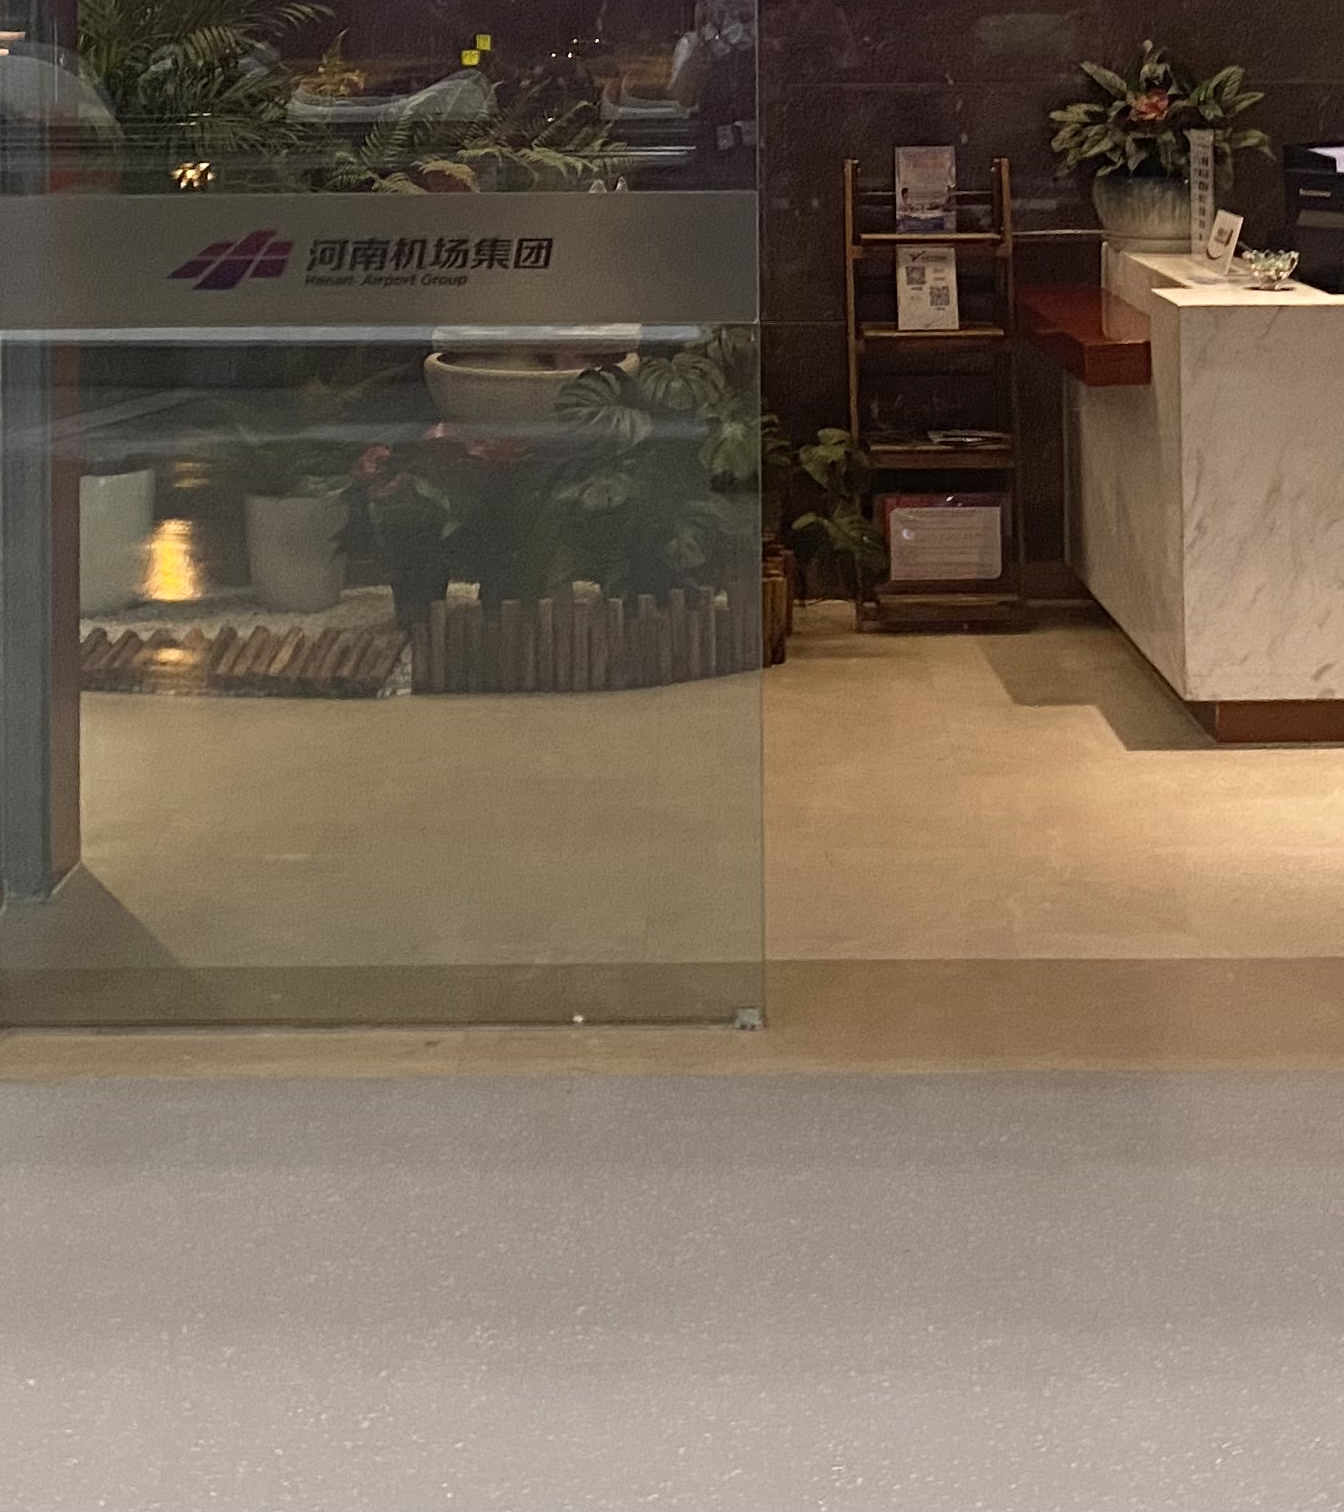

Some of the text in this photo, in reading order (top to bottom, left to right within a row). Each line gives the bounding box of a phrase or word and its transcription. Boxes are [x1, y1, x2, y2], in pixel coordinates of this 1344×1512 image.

[305, 237, 555, 271] 河南机场集团
[305, 274, 468, 287] Henan Airport Group
